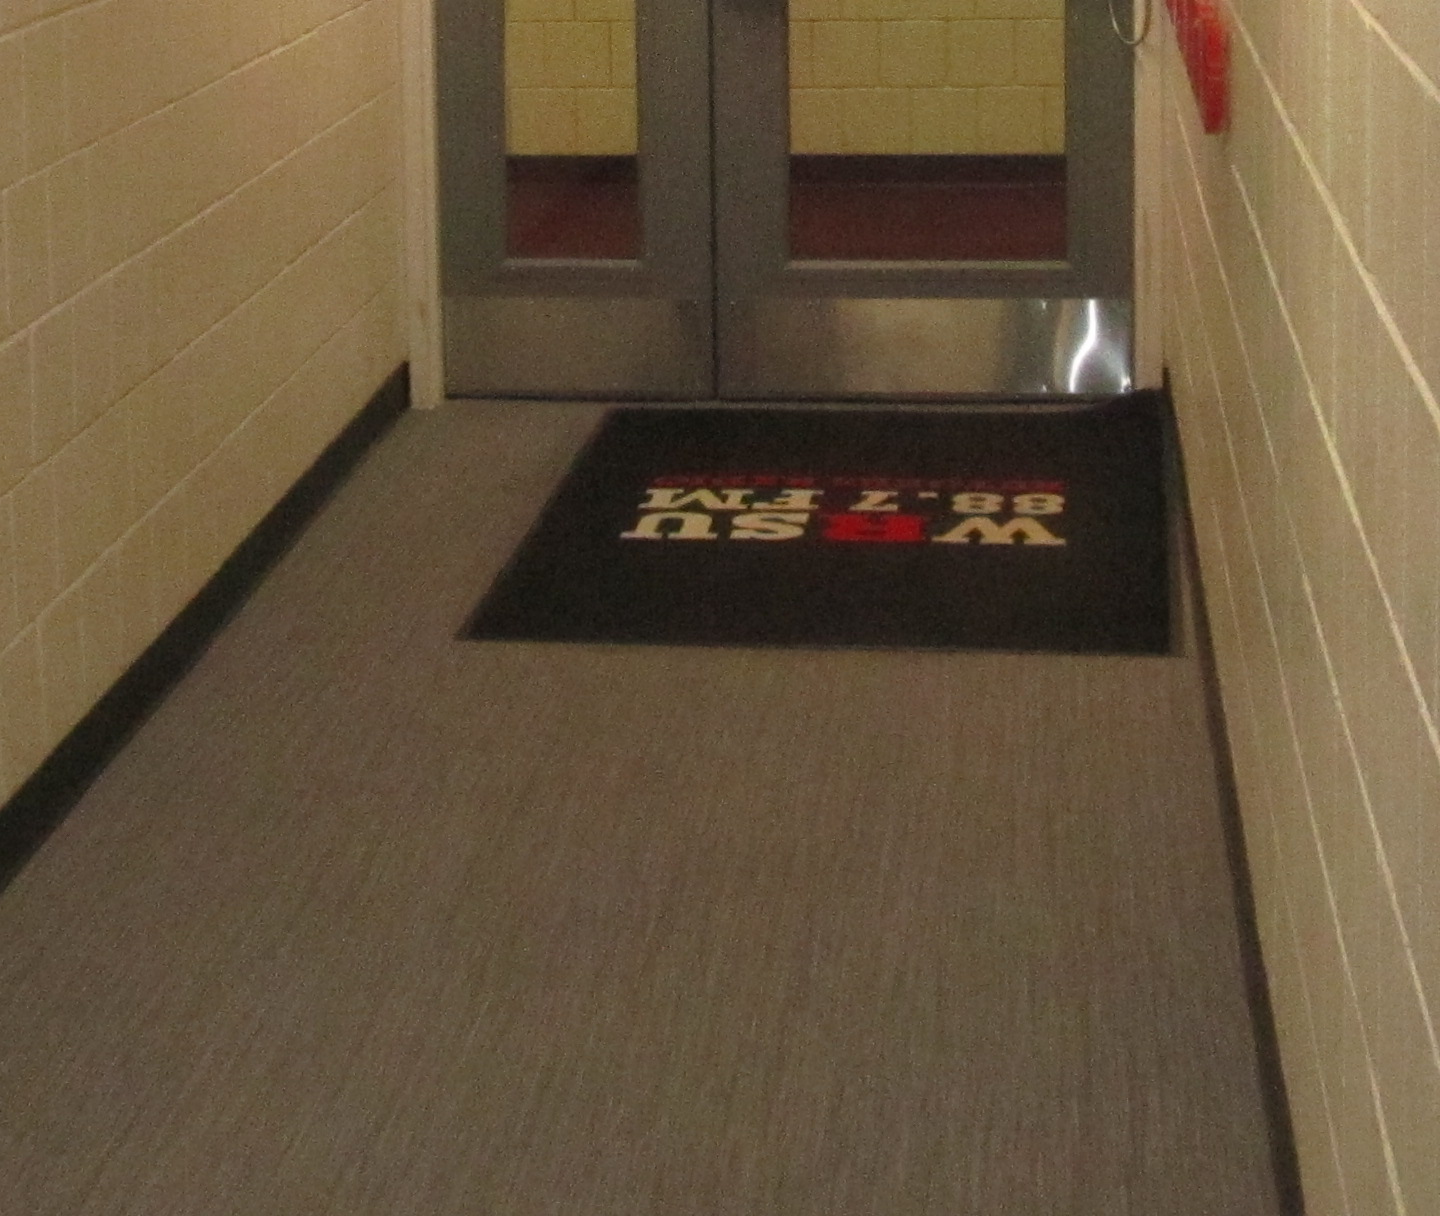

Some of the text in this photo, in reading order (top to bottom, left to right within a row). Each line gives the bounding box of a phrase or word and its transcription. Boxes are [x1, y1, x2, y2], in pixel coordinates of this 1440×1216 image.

[637, 488, 1065, 515] 88.7 FM
[620, 512, 1066, 545] WRSU
